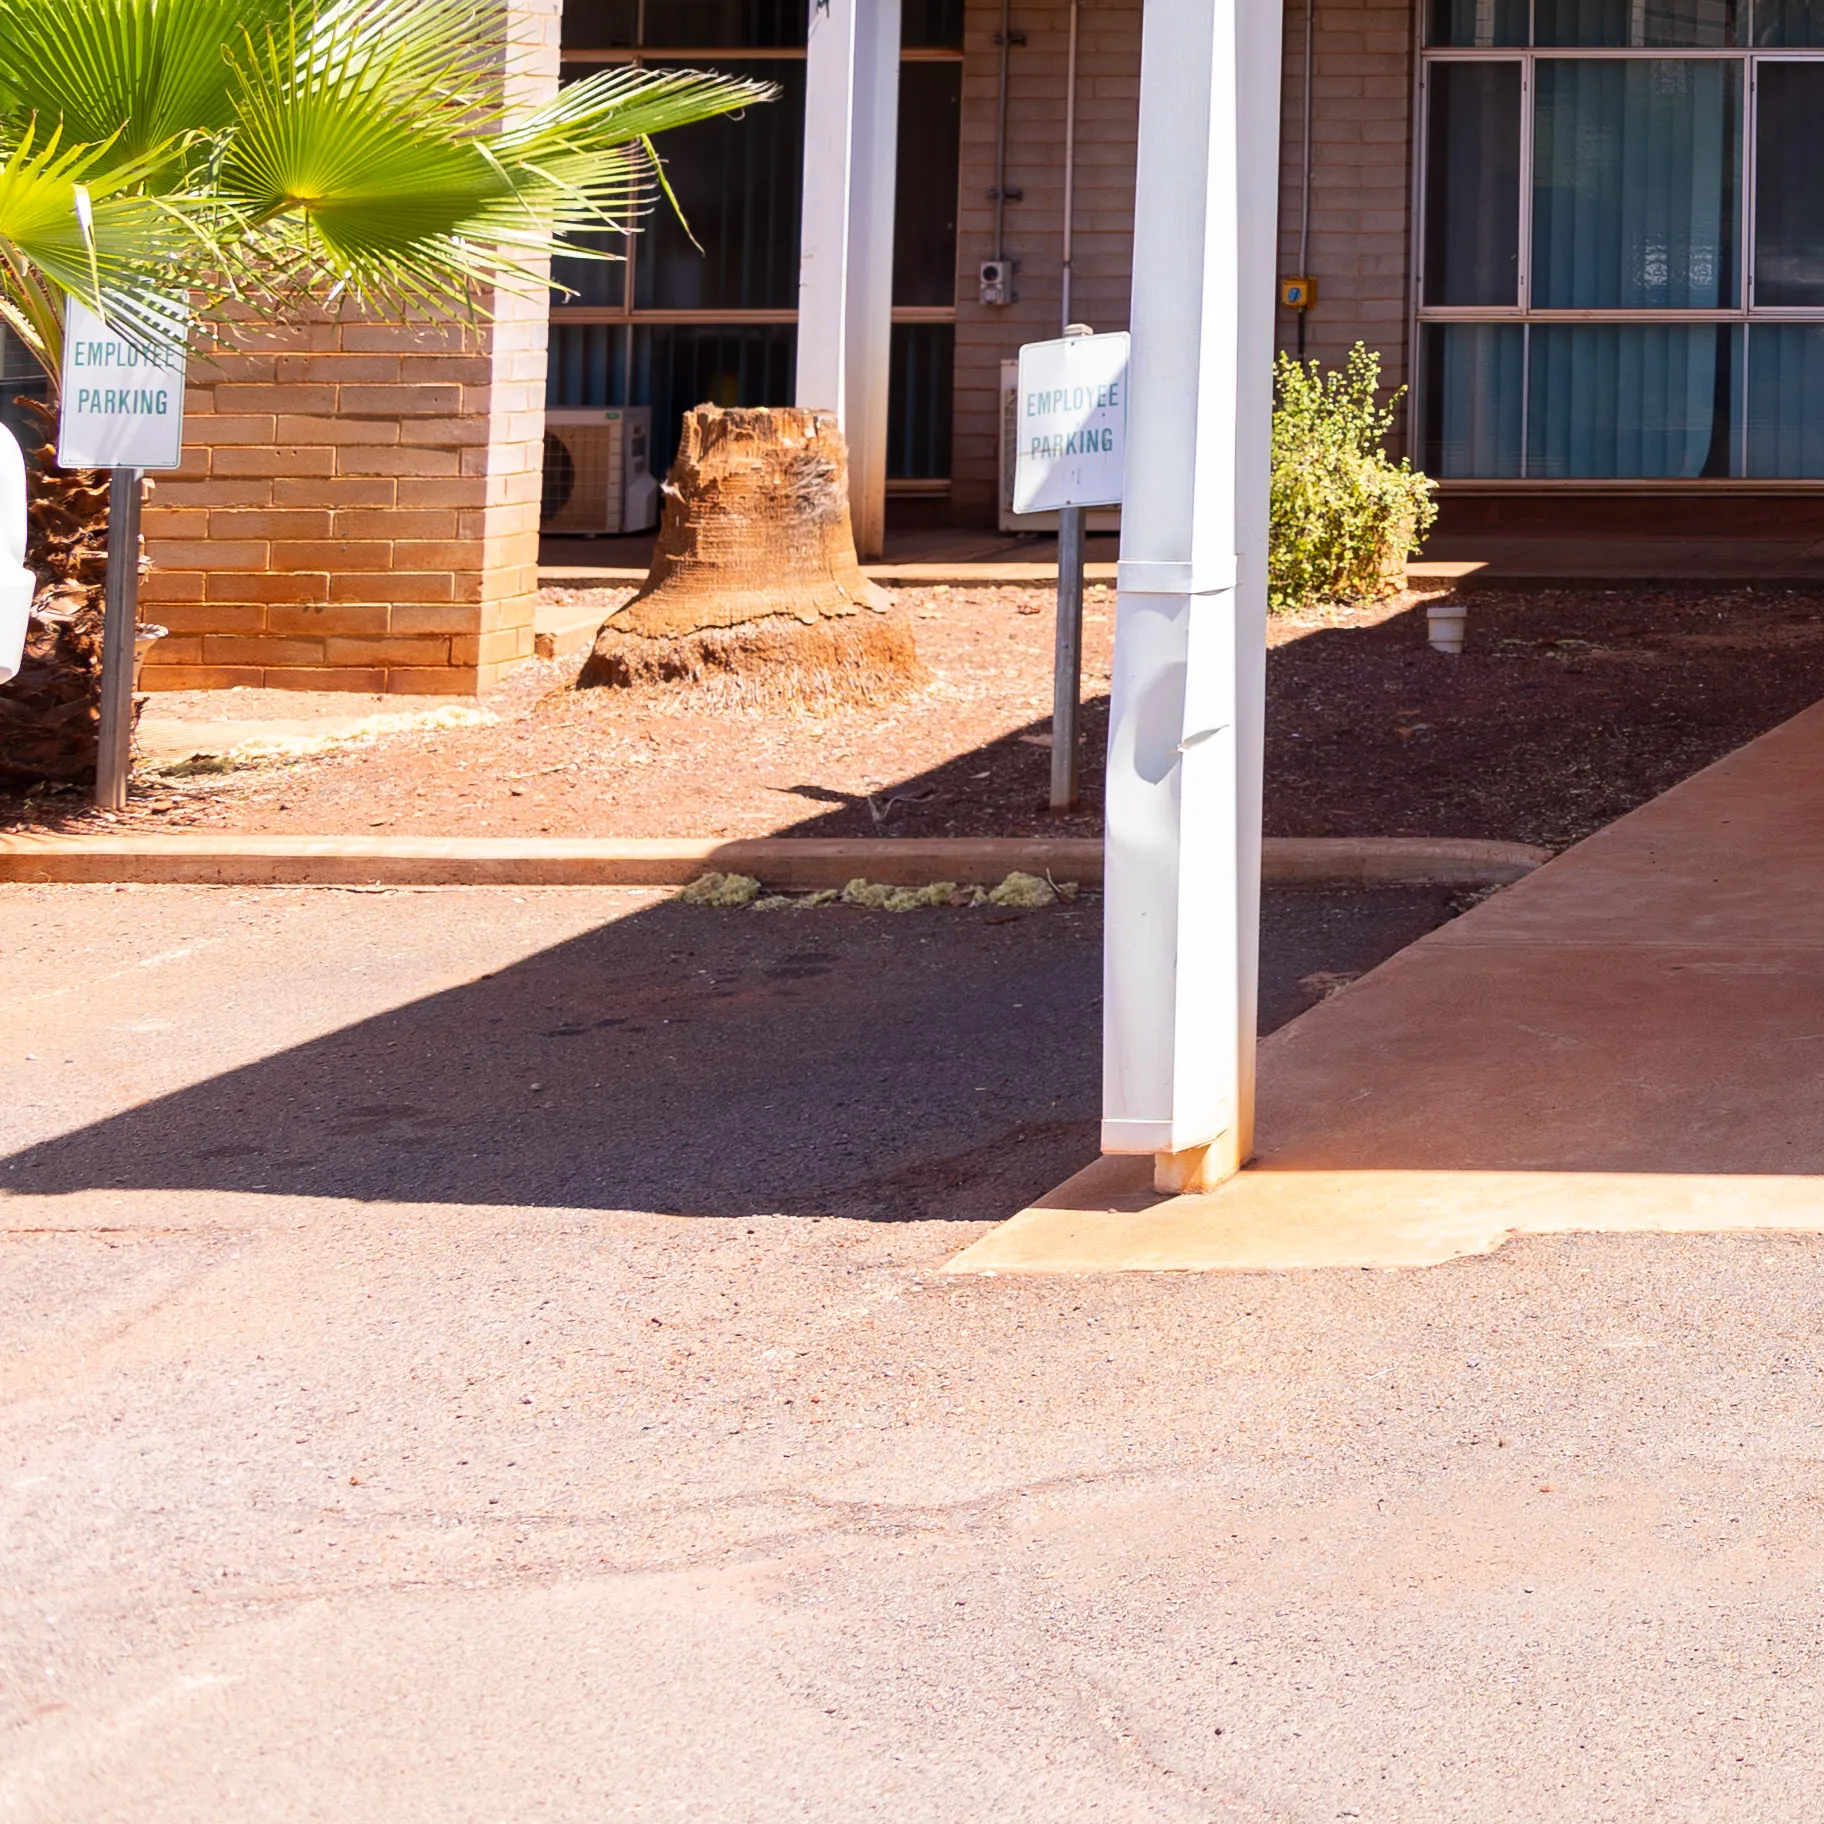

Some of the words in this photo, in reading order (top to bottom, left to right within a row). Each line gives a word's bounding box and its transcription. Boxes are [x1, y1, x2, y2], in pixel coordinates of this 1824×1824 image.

[77, 388, 168, 415] PARKING
[1026, 383, 1120, 417] EMPLOYEE
[1031, 427, 1113, 460] PARKING
